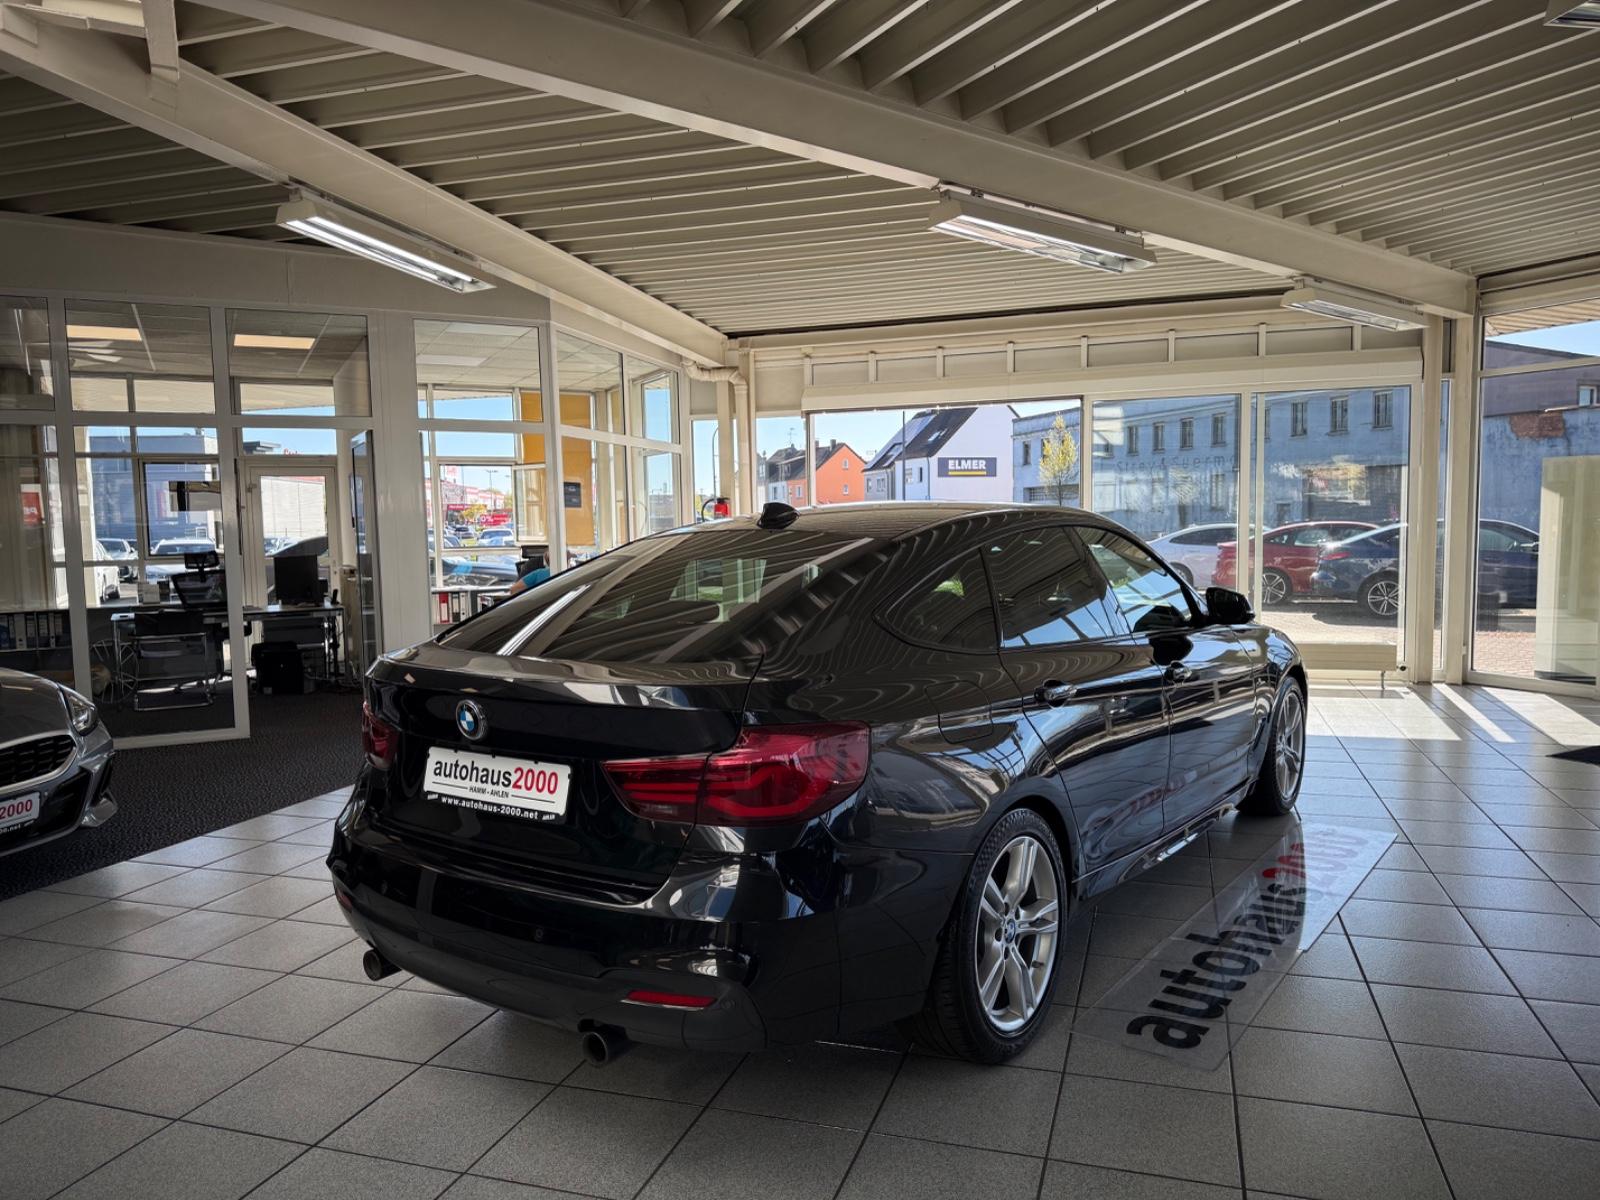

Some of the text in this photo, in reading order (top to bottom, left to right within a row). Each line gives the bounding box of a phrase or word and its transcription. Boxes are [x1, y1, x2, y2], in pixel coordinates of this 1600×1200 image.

[948, 459, 987, 470] ELMER
[433, 760, 558, 795] autohaus2000
[441, 796, 538, 820] www.autohaus-2000.net
